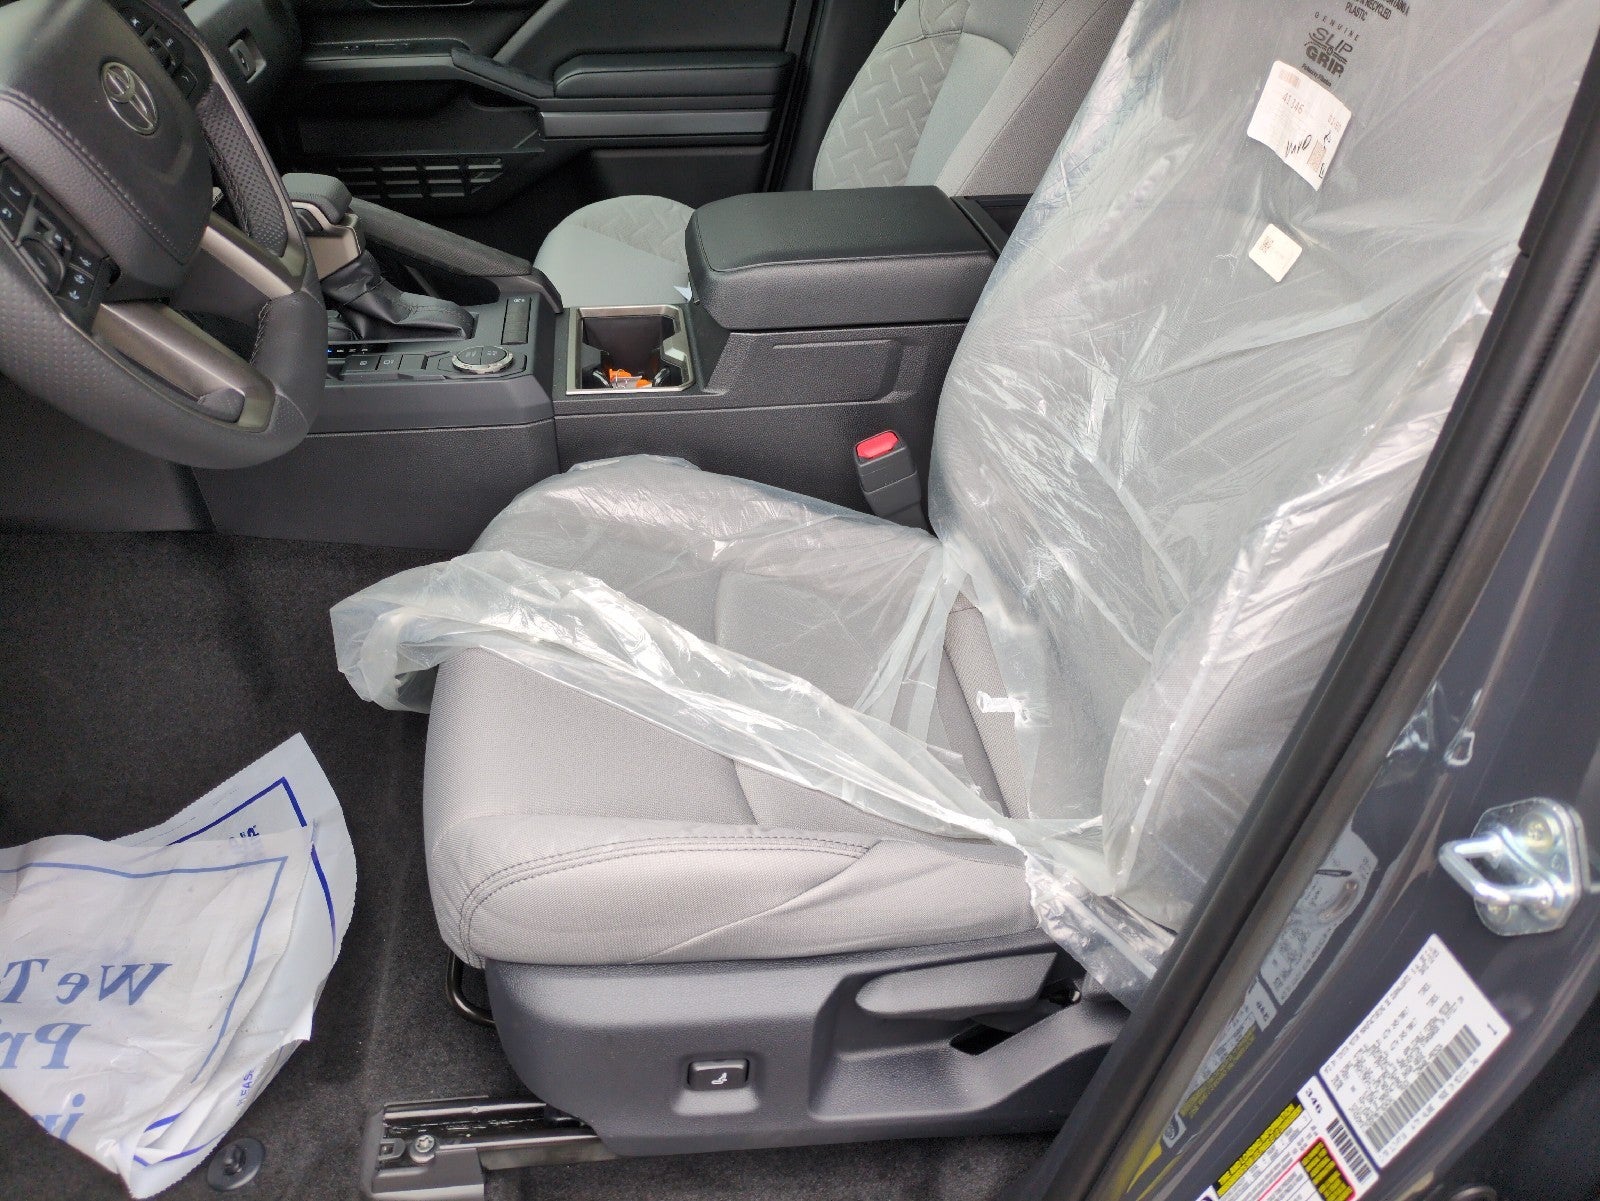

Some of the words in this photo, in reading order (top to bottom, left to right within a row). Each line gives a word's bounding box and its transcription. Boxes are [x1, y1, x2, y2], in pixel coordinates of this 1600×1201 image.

[1345, 1, 1367, 21] PLASTIC
[1312, 27, 1353, 53] SLIP
[1314, 11, 1360, 41] GENUINE
[1305, 45, 1344, 76] GRIP
